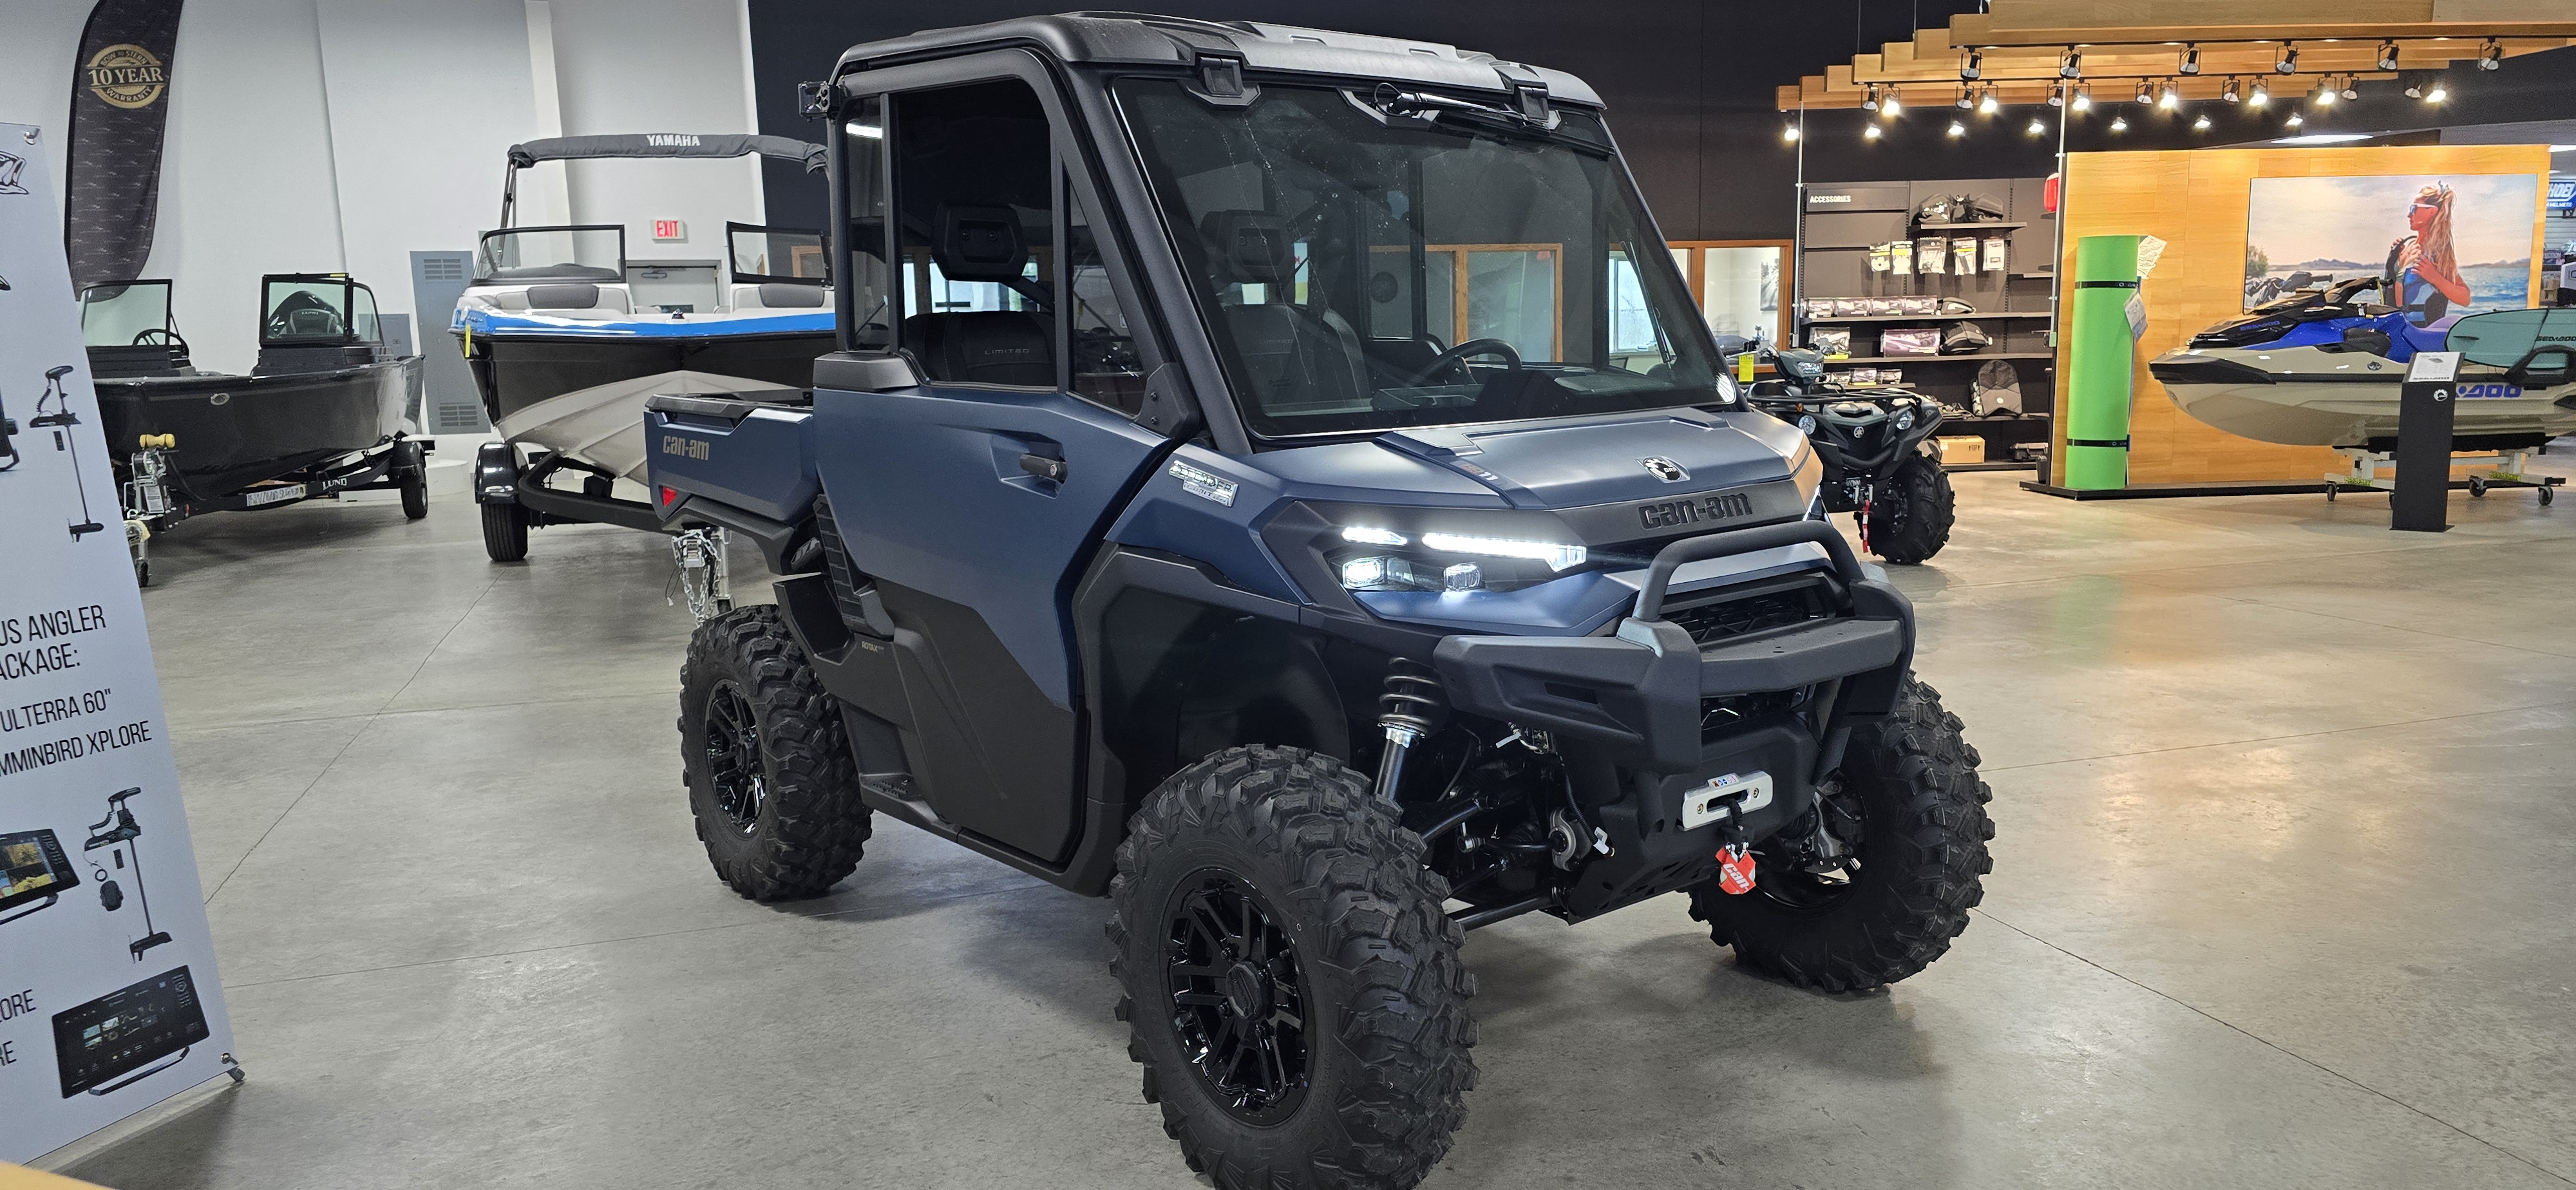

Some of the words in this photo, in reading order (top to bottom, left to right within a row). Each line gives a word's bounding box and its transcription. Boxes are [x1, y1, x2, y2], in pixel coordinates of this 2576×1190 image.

[88, 68, 112, 86] 10
[115, 67, 164, 83] YEAR
[106, 86, 152, 102] WARRANTY
[647, 134, 700, 147] YAMAHA
[2548, 183, 2575, 198] HOEI
[656, 220, 678, 237] EXIT
[663, 435, 710, 460] can-am
[323, 478, 347, 491] LUND
[1638, 493, 1753, 530] can-am
[29, 605, 106, 641] ANGLER
[0, 696, 81, 732] ULTERRA
[83, 688, 111, 713] 60"
[86, 721, 152, 755] XPLORE
[0, 989, 36, 1023] ORE
